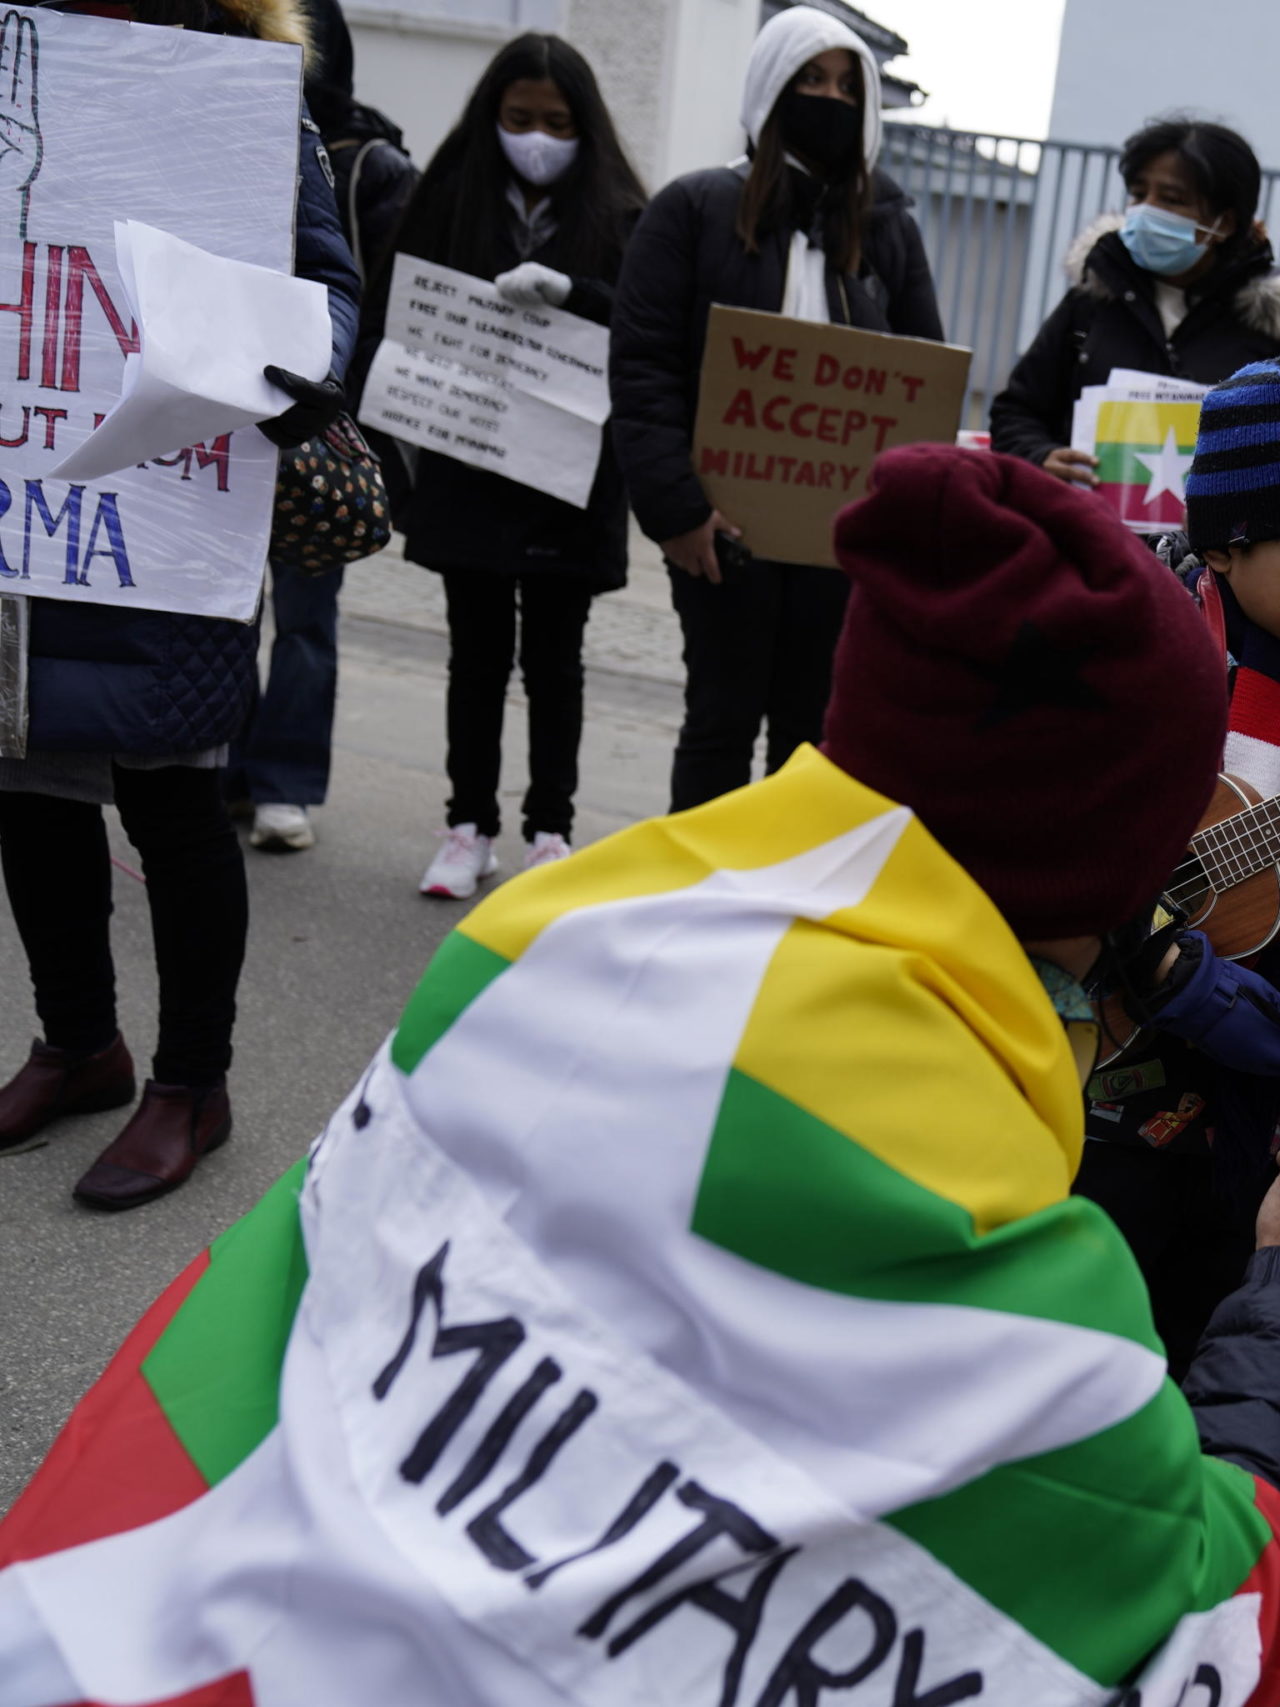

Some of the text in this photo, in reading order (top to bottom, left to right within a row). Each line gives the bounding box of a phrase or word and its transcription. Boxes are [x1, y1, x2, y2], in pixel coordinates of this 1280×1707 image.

[410, 299, 437, 318] FREE
[413, 275, 457, 298] REJECT
[731, 336, 925, 403] WE DON'T
[722, 388, 897, 451] ACCEPT
[699, 446, 860, 492] MILITARY
[371, 1238, 984, 1707] MILITARY
